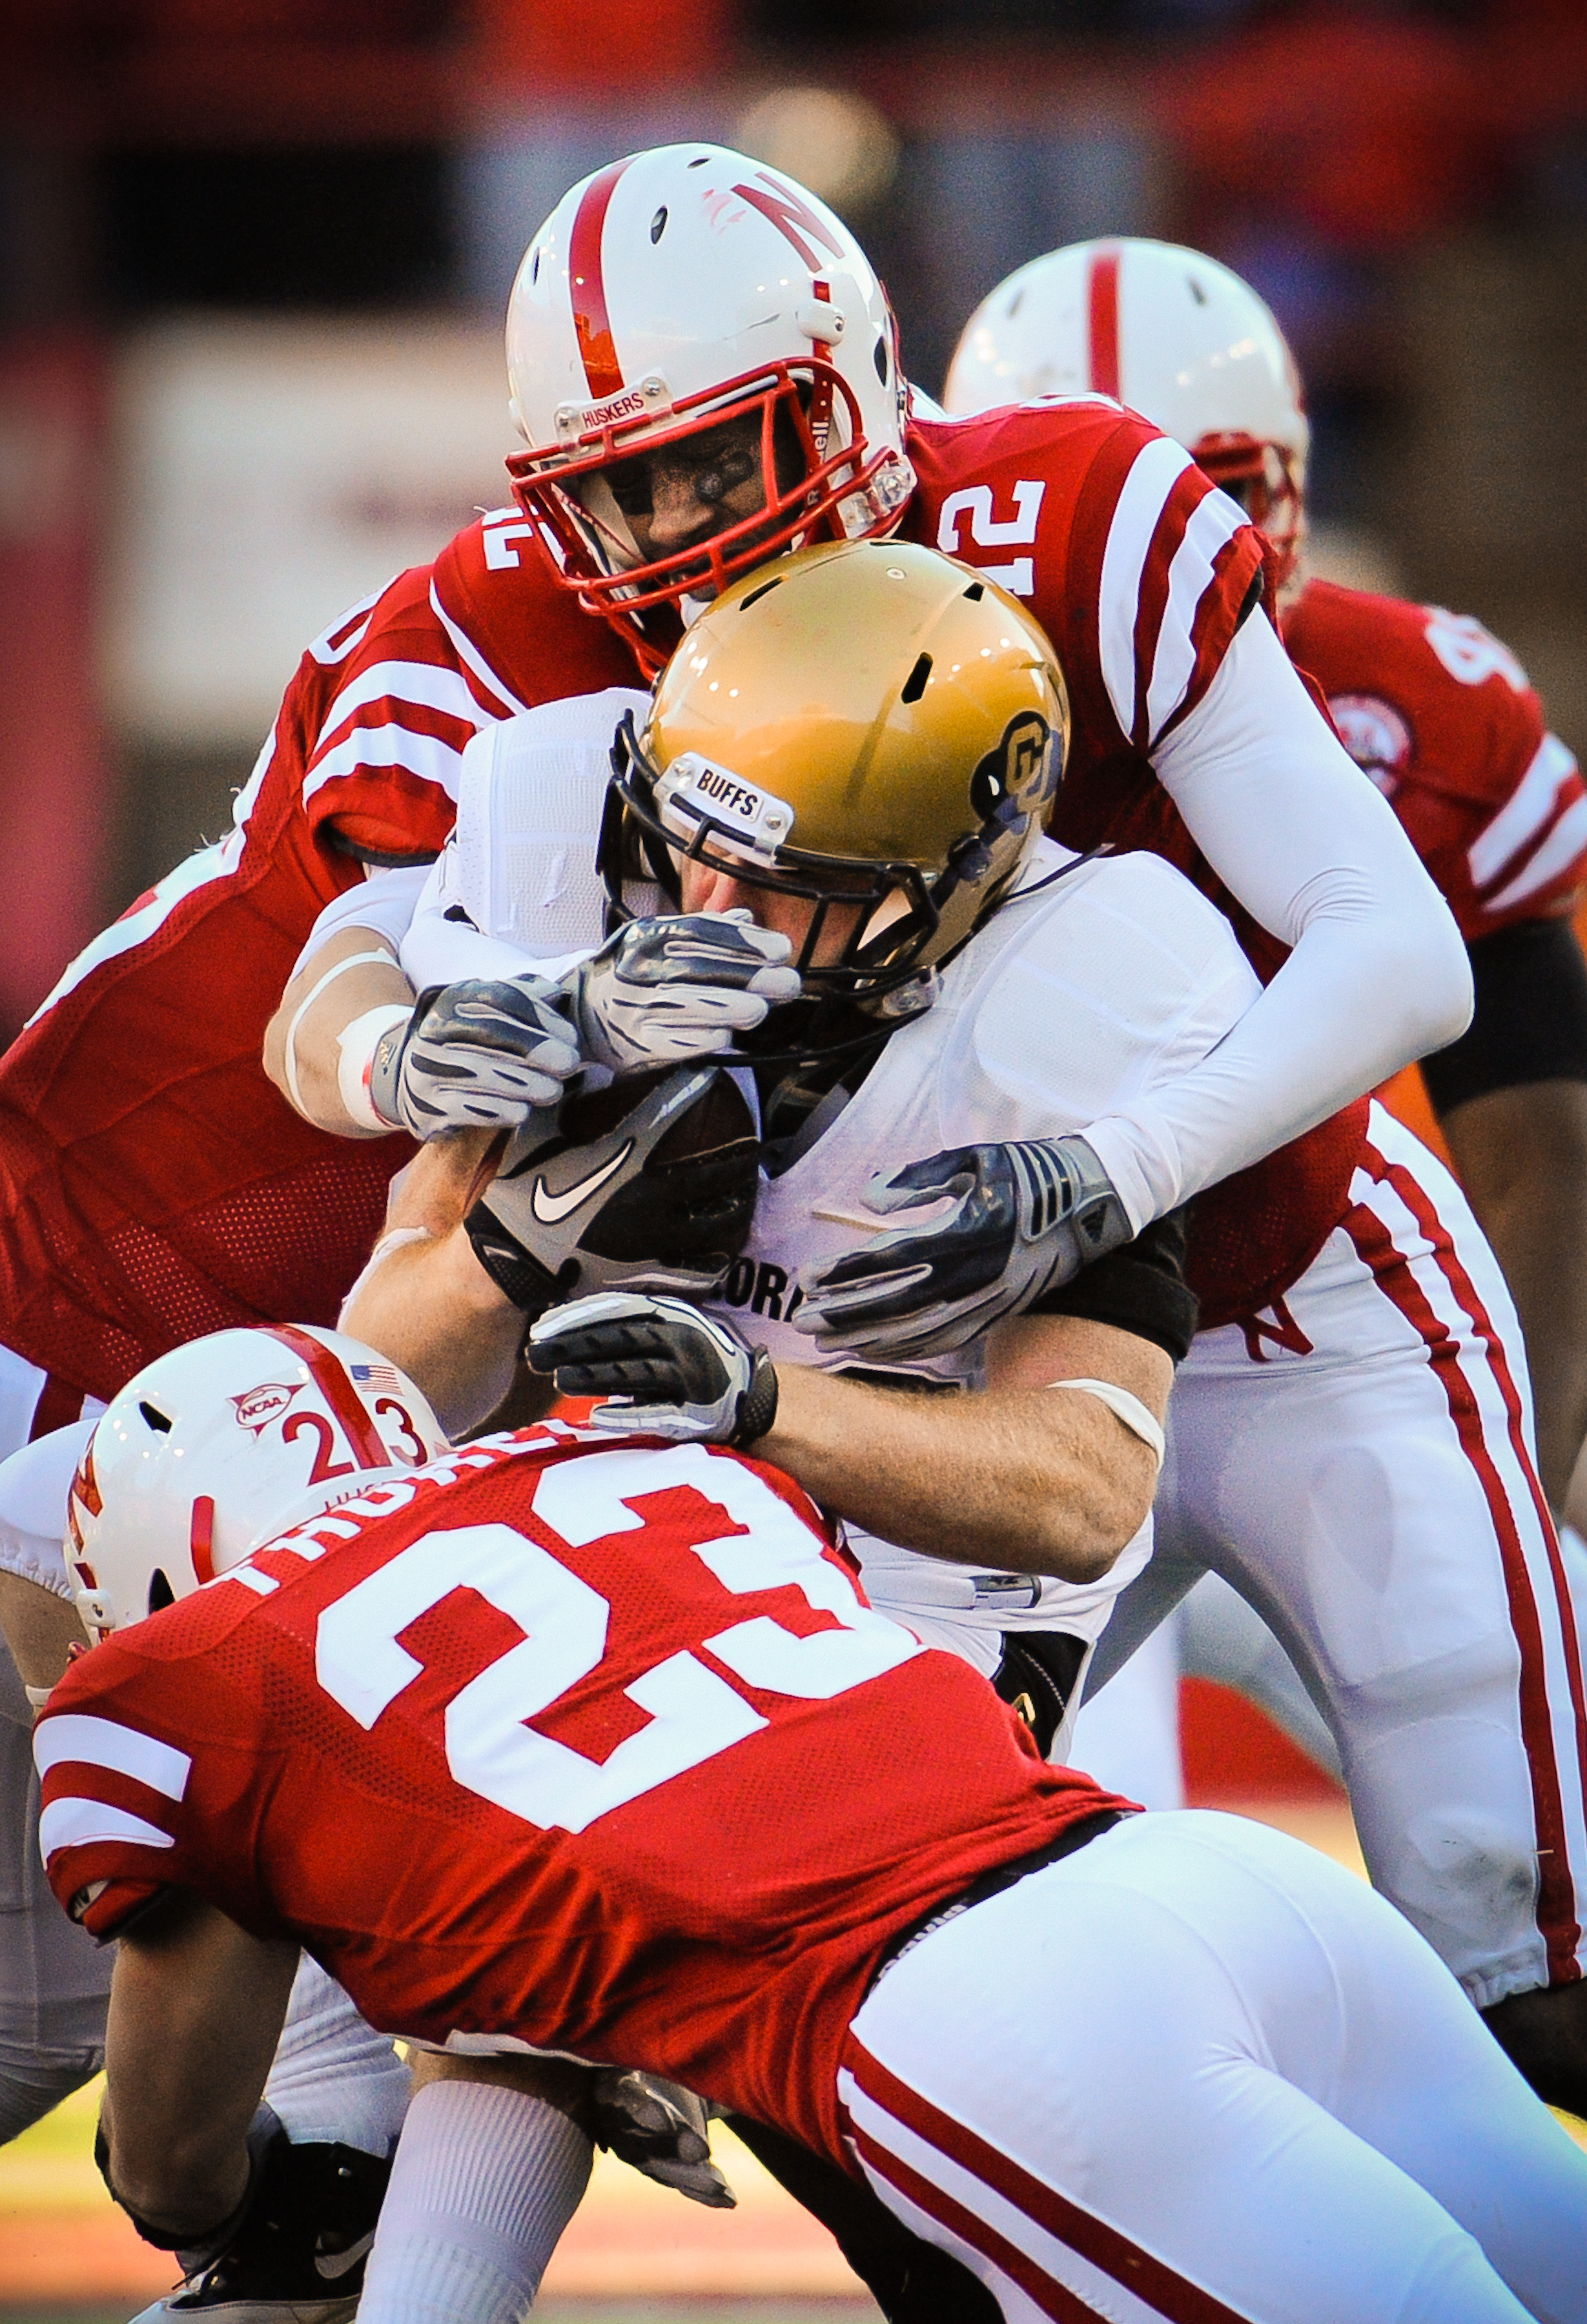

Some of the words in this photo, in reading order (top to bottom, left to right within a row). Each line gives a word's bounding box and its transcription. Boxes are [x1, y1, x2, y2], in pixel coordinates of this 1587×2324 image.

[730, 172, 846, 273] N
[582, 392, 644, 428] HUSKERS
[936, 480, 1046, 596] 12
[697, 768, 758, 815] BUFFS
[240, 1396, 284, 1420] NCAA
[315, 1443, 930, 1835] 23
